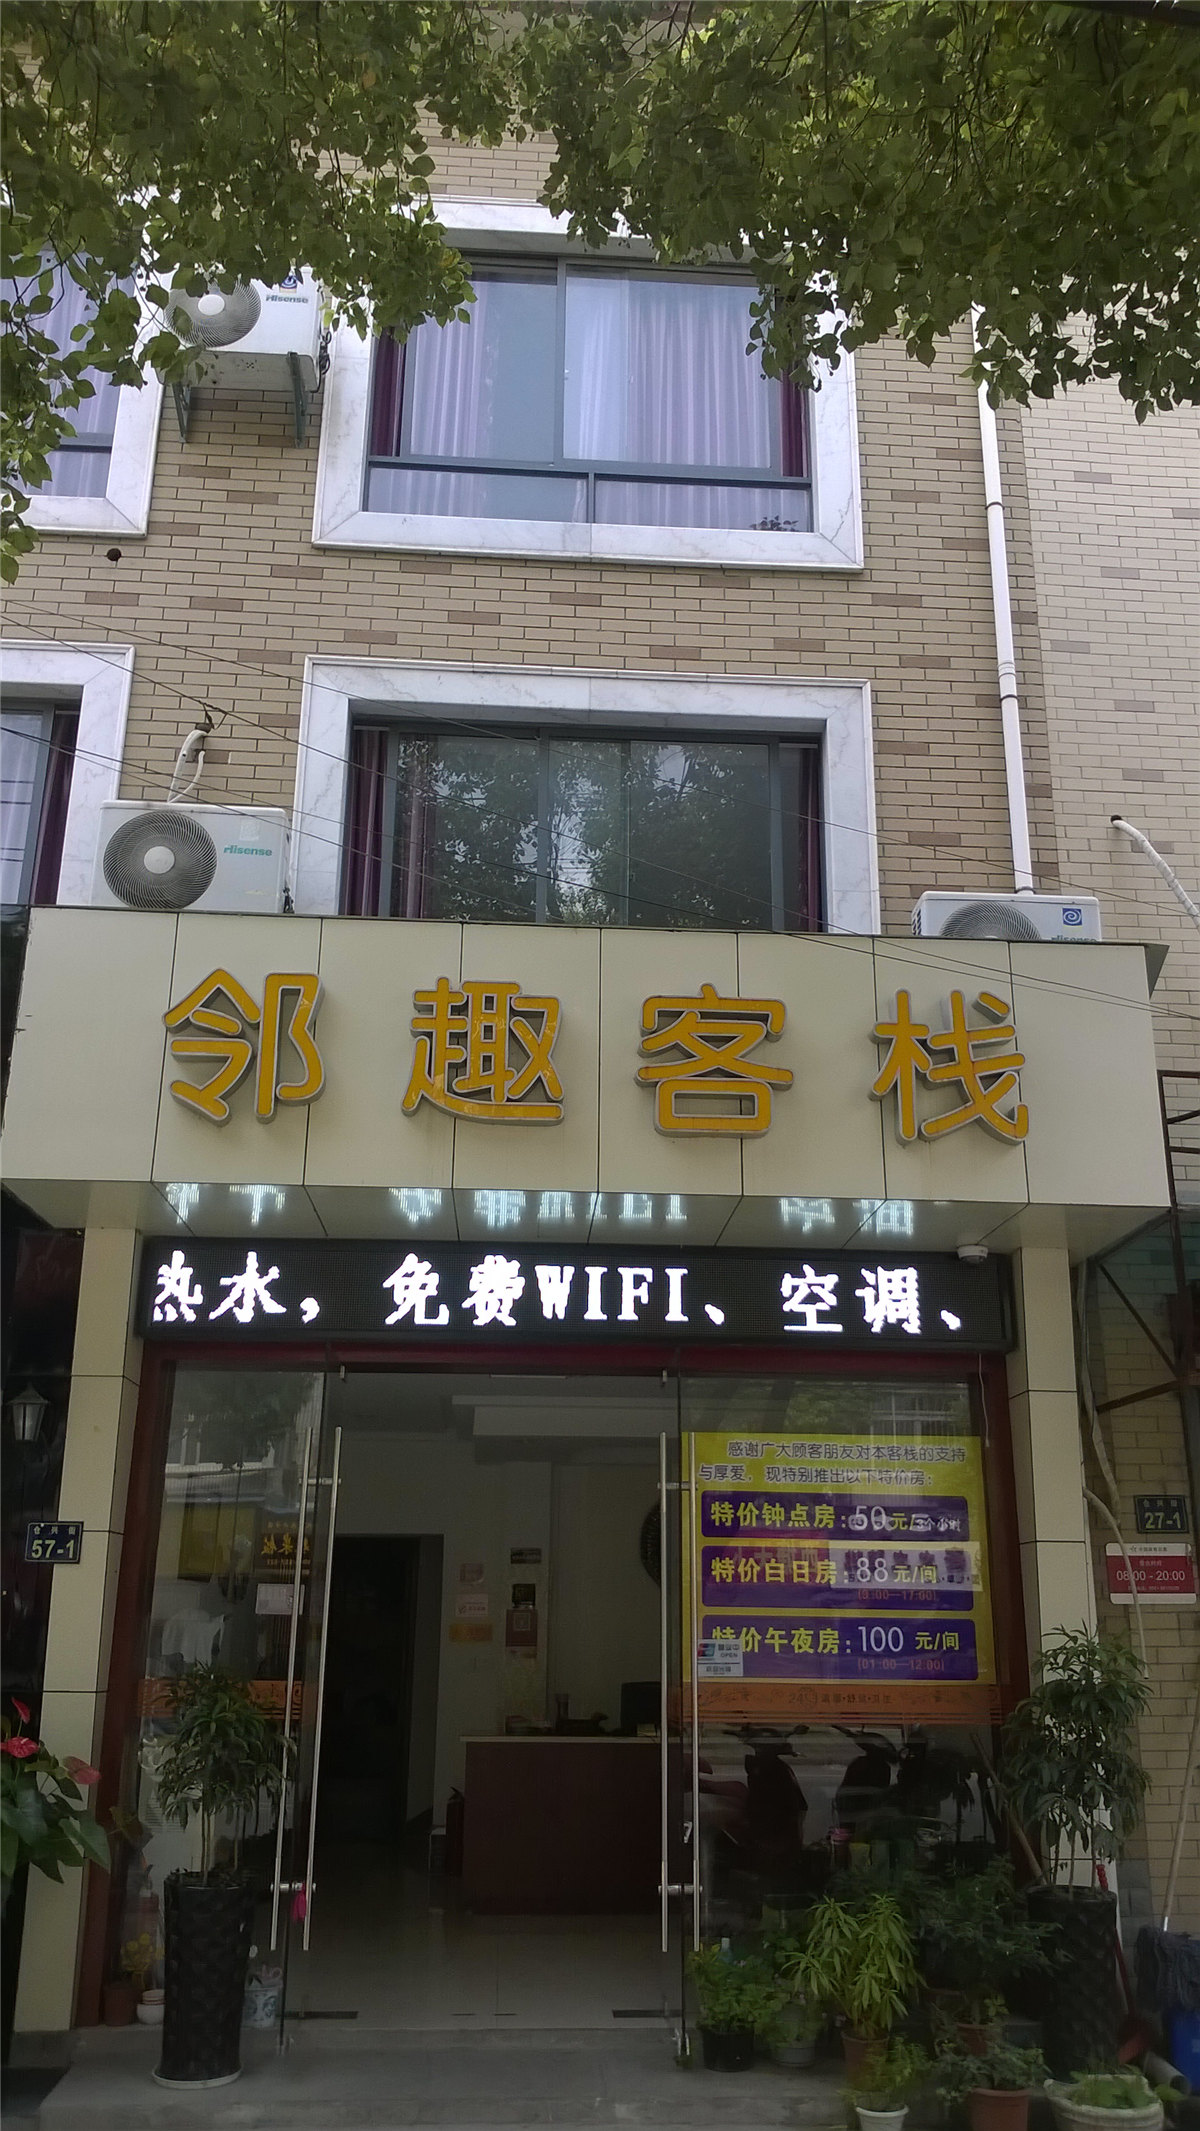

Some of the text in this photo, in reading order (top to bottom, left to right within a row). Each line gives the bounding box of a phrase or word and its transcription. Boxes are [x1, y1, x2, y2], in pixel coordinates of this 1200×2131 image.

[265, 294, 309, 304] Hisense
[223, 844, 273, 857] Hisense
[162, 967, 1030, 1144] 邻趣客栈
[727, 1440, 967, 1463] 感谢广大顾客朋友对本客栈的支持
[1144, 1511, 1181, 1529] 27-1
[31, 1539, 75, 1559] 57-1
[1116, 1570, 1146, 1581] 0800
